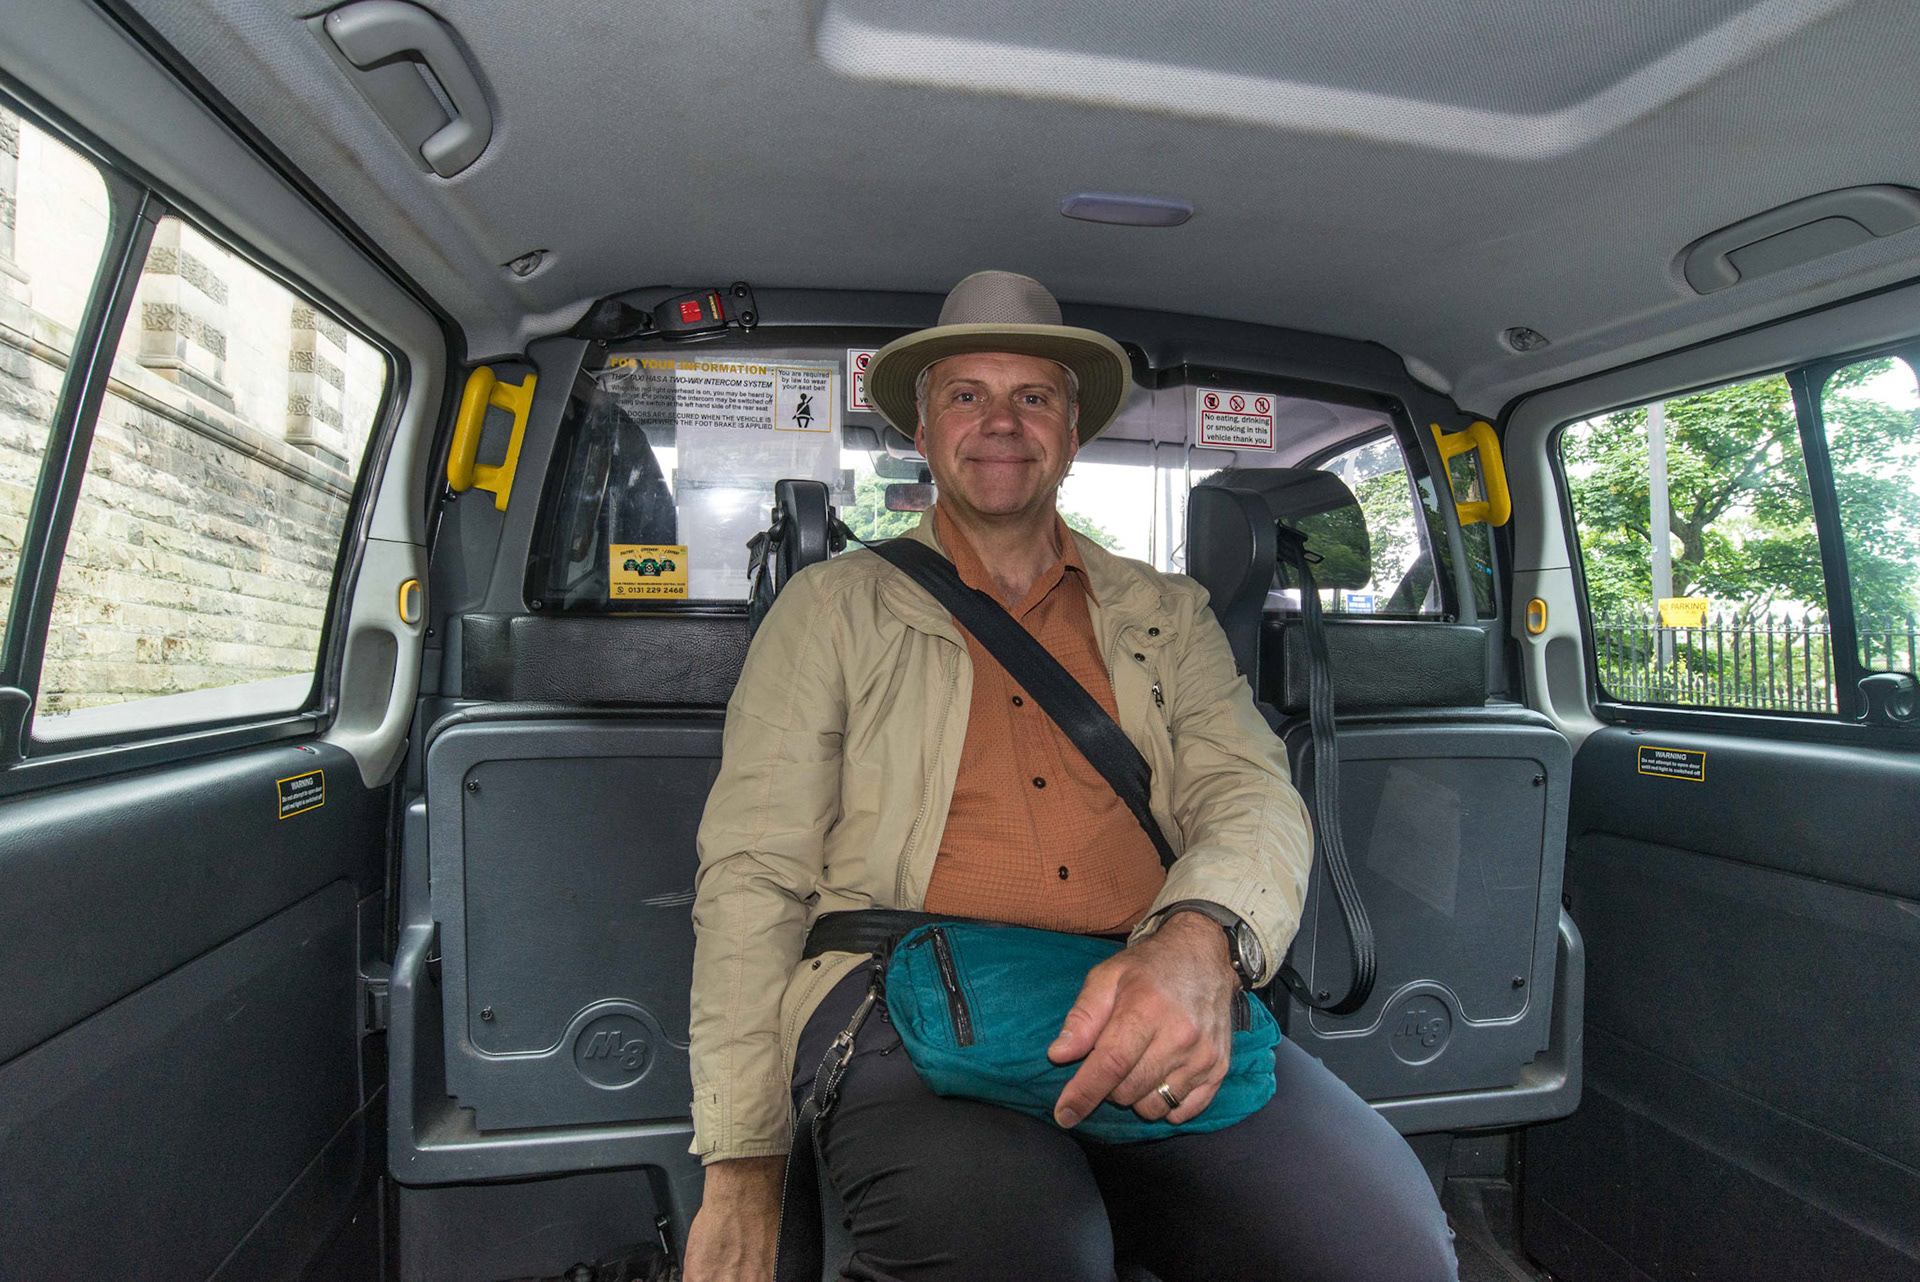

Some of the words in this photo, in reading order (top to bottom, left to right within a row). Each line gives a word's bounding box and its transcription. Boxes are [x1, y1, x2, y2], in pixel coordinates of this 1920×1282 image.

[610, 358, 637, 368] FOR
[642, 360, 676, 370] YOUR
[680, 362, 766, 375] INFORMATION
[704, 378, 742, 387] INTERCOM
[1242, 417, 1270, 426] drinking
[1215, 425, 1245, 434] smoking
[1655, 751, 1687, 760] WARNING
[291, 777, 313, 790] WARNING
[584, 1031, 646, 1071] M8
